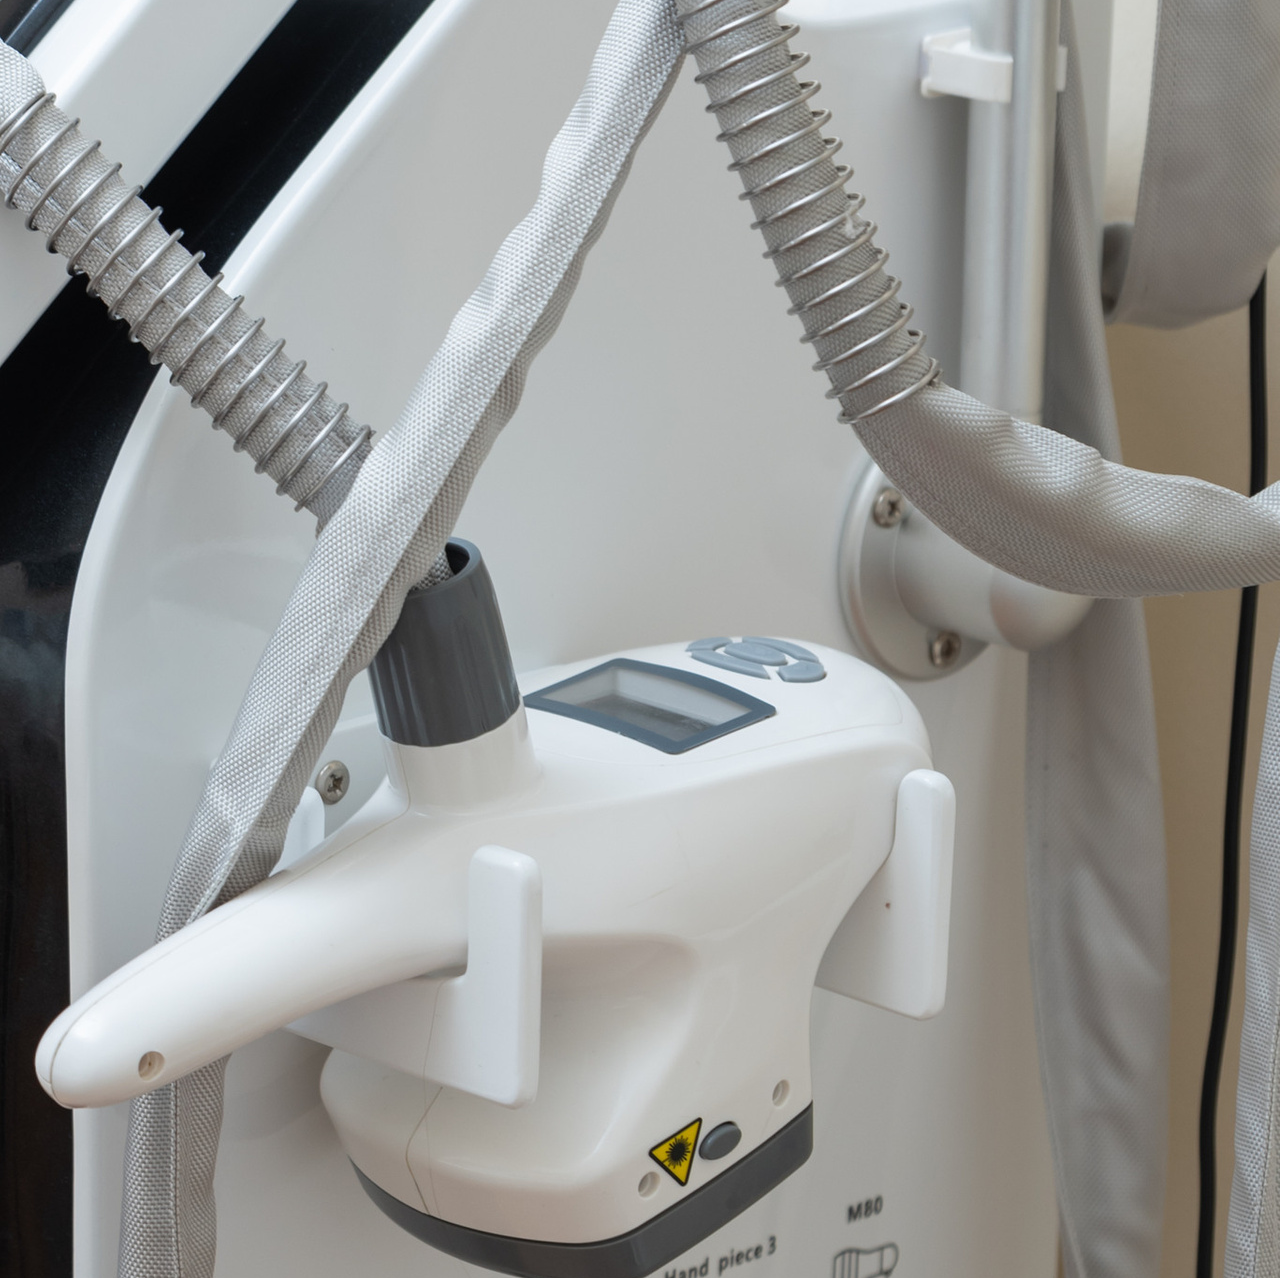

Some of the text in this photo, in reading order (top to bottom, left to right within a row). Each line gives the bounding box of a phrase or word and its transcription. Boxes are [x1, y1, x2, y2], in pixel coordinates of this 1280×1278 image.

[847, 1195, 883, 1224] M80
[718, 1240, 763, 1277] piece
[767, 1235, 777, 1256] 3
